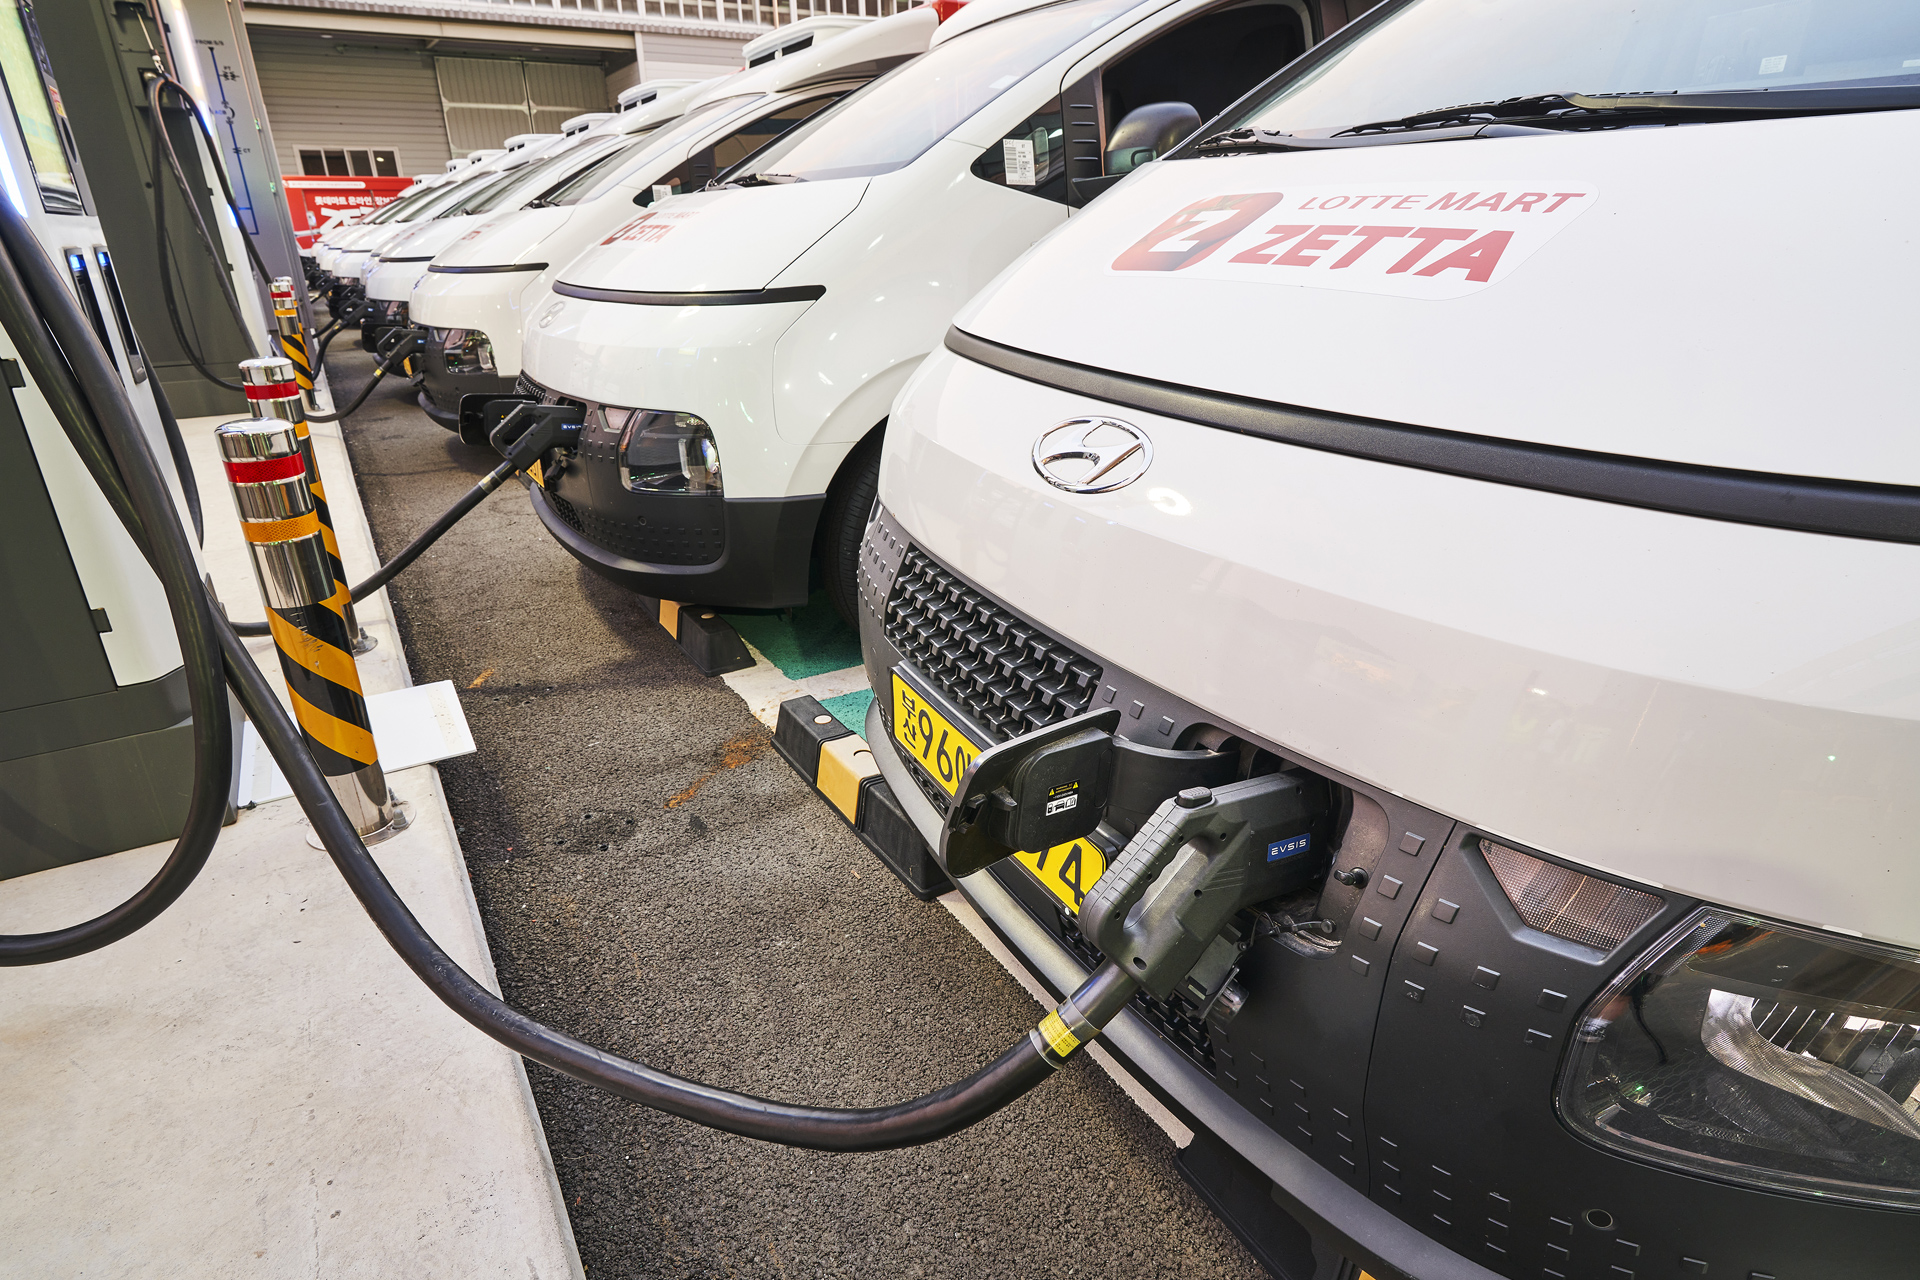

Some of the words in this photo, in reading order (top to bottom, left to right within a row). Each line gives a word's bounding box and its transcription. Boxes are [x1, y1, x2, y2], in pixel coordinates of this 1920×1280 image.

[314, 196, 348, 206] 롯데마트
[348, 196, 373, 206] 온라인
[1298, 194, 1429, 211] LOTTE
[1425, 191, 1587, 215] MART
[1226, 224, 1516, 284] ZETTA
[902, 689, 917, 750] 부산
[1271, 838, 1307, 856] EVSIS
